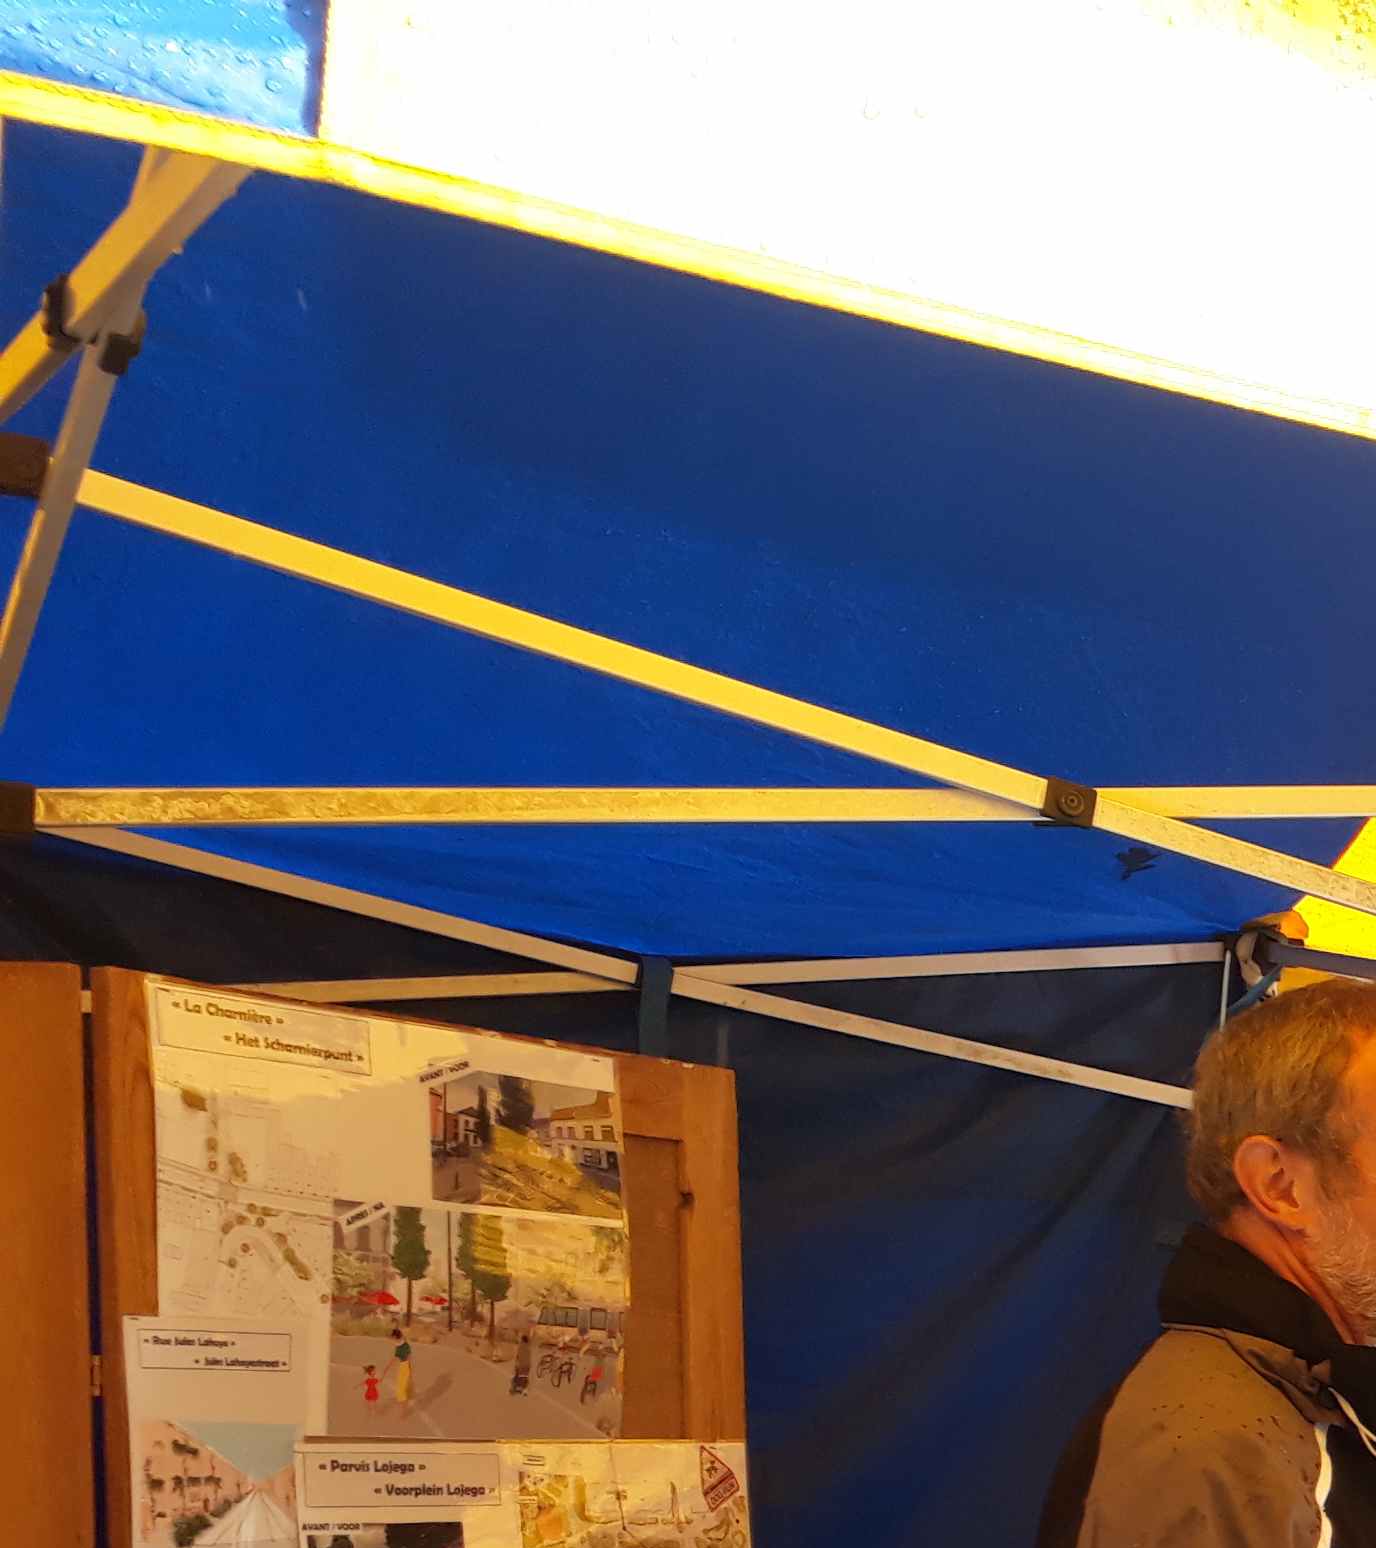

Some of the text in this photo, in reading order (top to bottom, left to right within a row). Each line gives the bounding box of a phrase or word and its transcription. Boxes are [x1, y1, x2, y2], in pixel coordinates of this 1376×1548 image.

[183, 999, 202, 1014] La
[235, 1032, 260, 1049] Het
[330, 1460, 370, 1473] Parvis
[374, 1461, 415, 1474] Lojega
[385, 1483, 443, 1498] Voorplein
[447, 1484, 486, 1497] Lojega
